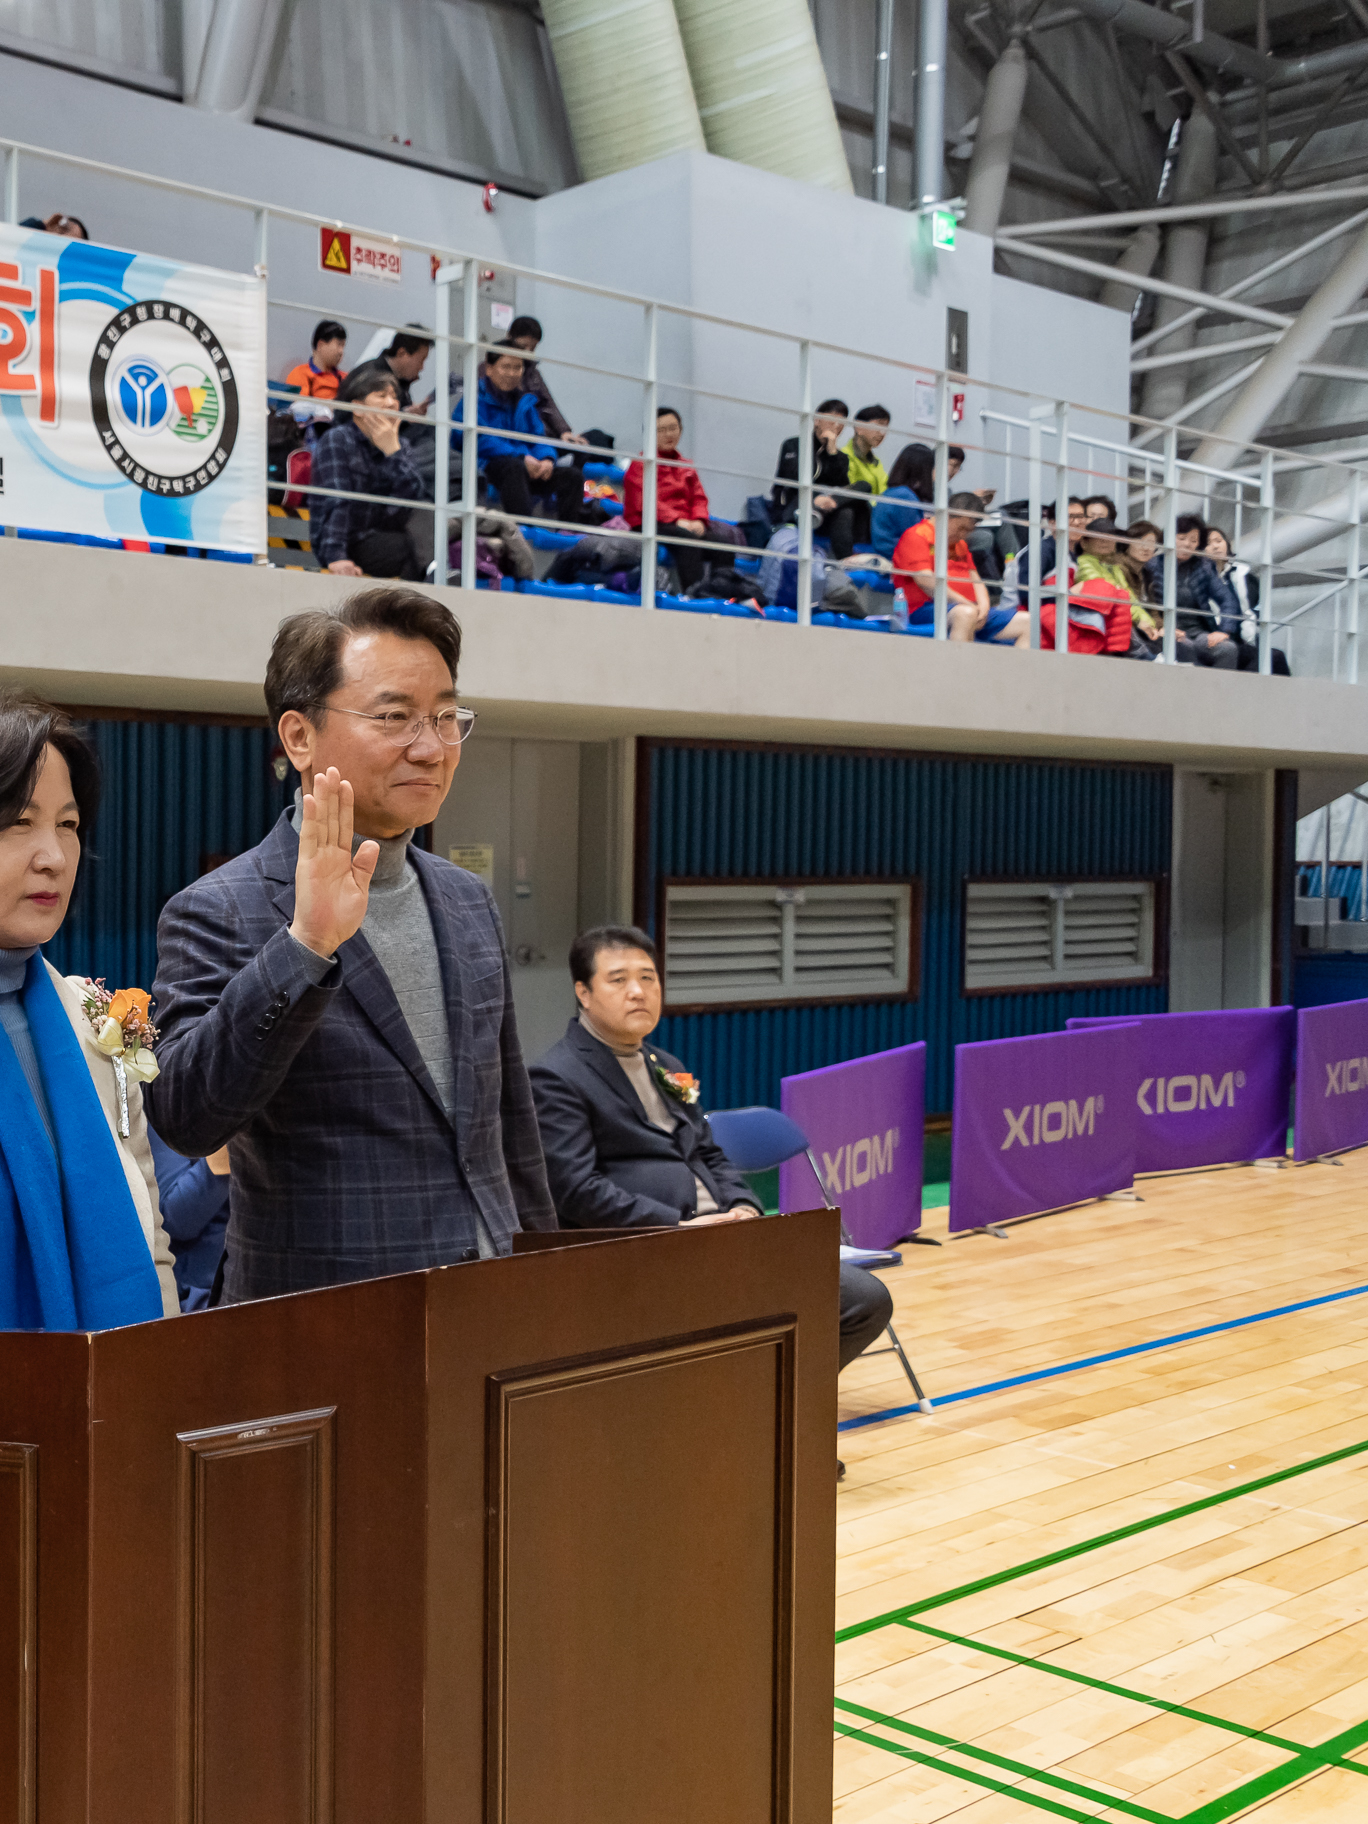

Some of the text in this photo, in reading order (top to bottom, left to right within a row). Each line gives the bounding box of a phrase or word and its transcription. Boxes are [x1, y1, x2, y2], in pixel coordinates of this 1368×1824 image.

[352, 246, 401, 274] 추락주의
[1000, 1096, 1095, 1150] XIOM
[822, 1128, 894, 1194] XIOM
